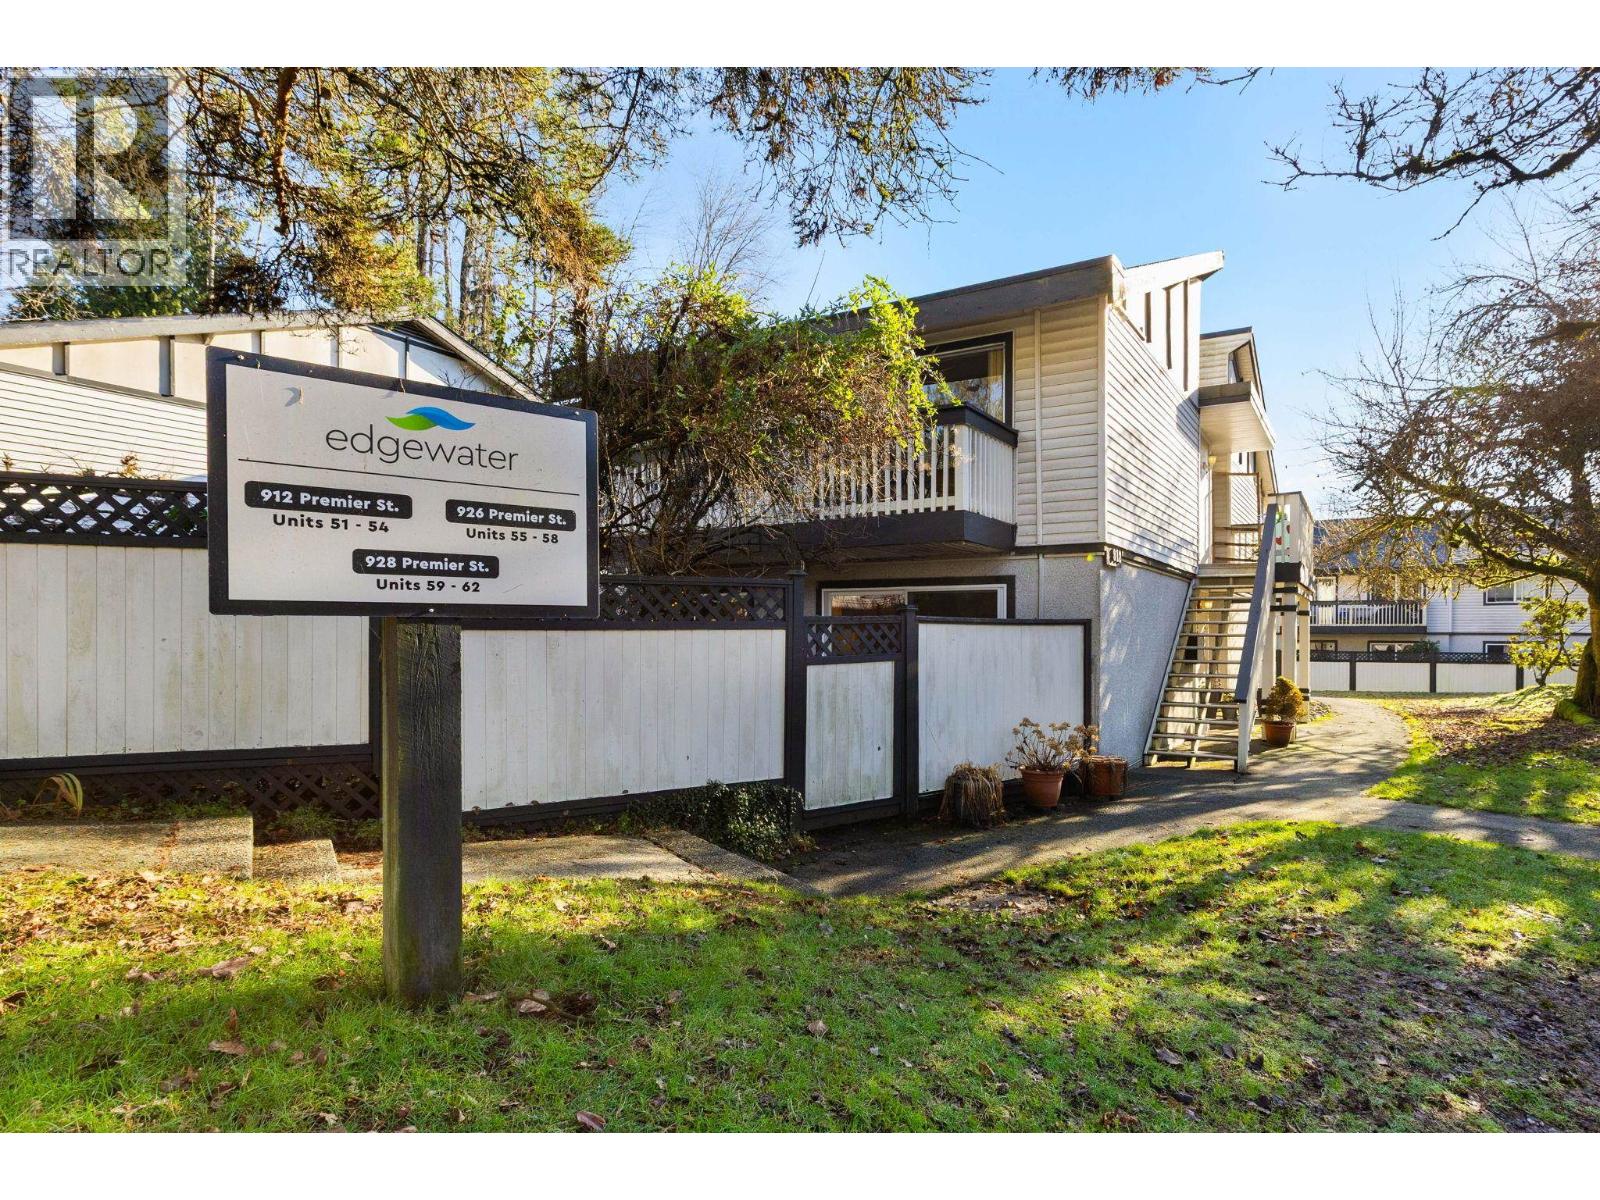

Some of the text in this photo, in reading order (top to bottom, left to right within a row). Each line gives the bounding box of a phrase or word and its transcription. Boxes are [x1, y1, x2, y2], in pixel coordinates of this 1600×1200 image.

[325, 423, 519, 471] edgewater
[260, 488, 399, 512] 912 Premier St.
[272, 513, 324, 529] Units
[330, 517, 349, 530] 51
[368, 520, 389, 533] 54
[456, 505, 567, 525] 926 Premier St.
[466, 527, 506, 540] Units
[510, 530, 528, 541] 55
[542, 533, 559, 544] 58
[365, 555, 490, 573] 928 Premier St.
[376, 577, 421, 591] Units
[426, 580, 446, 592] 59
[461, 581, 481, 592] 62
